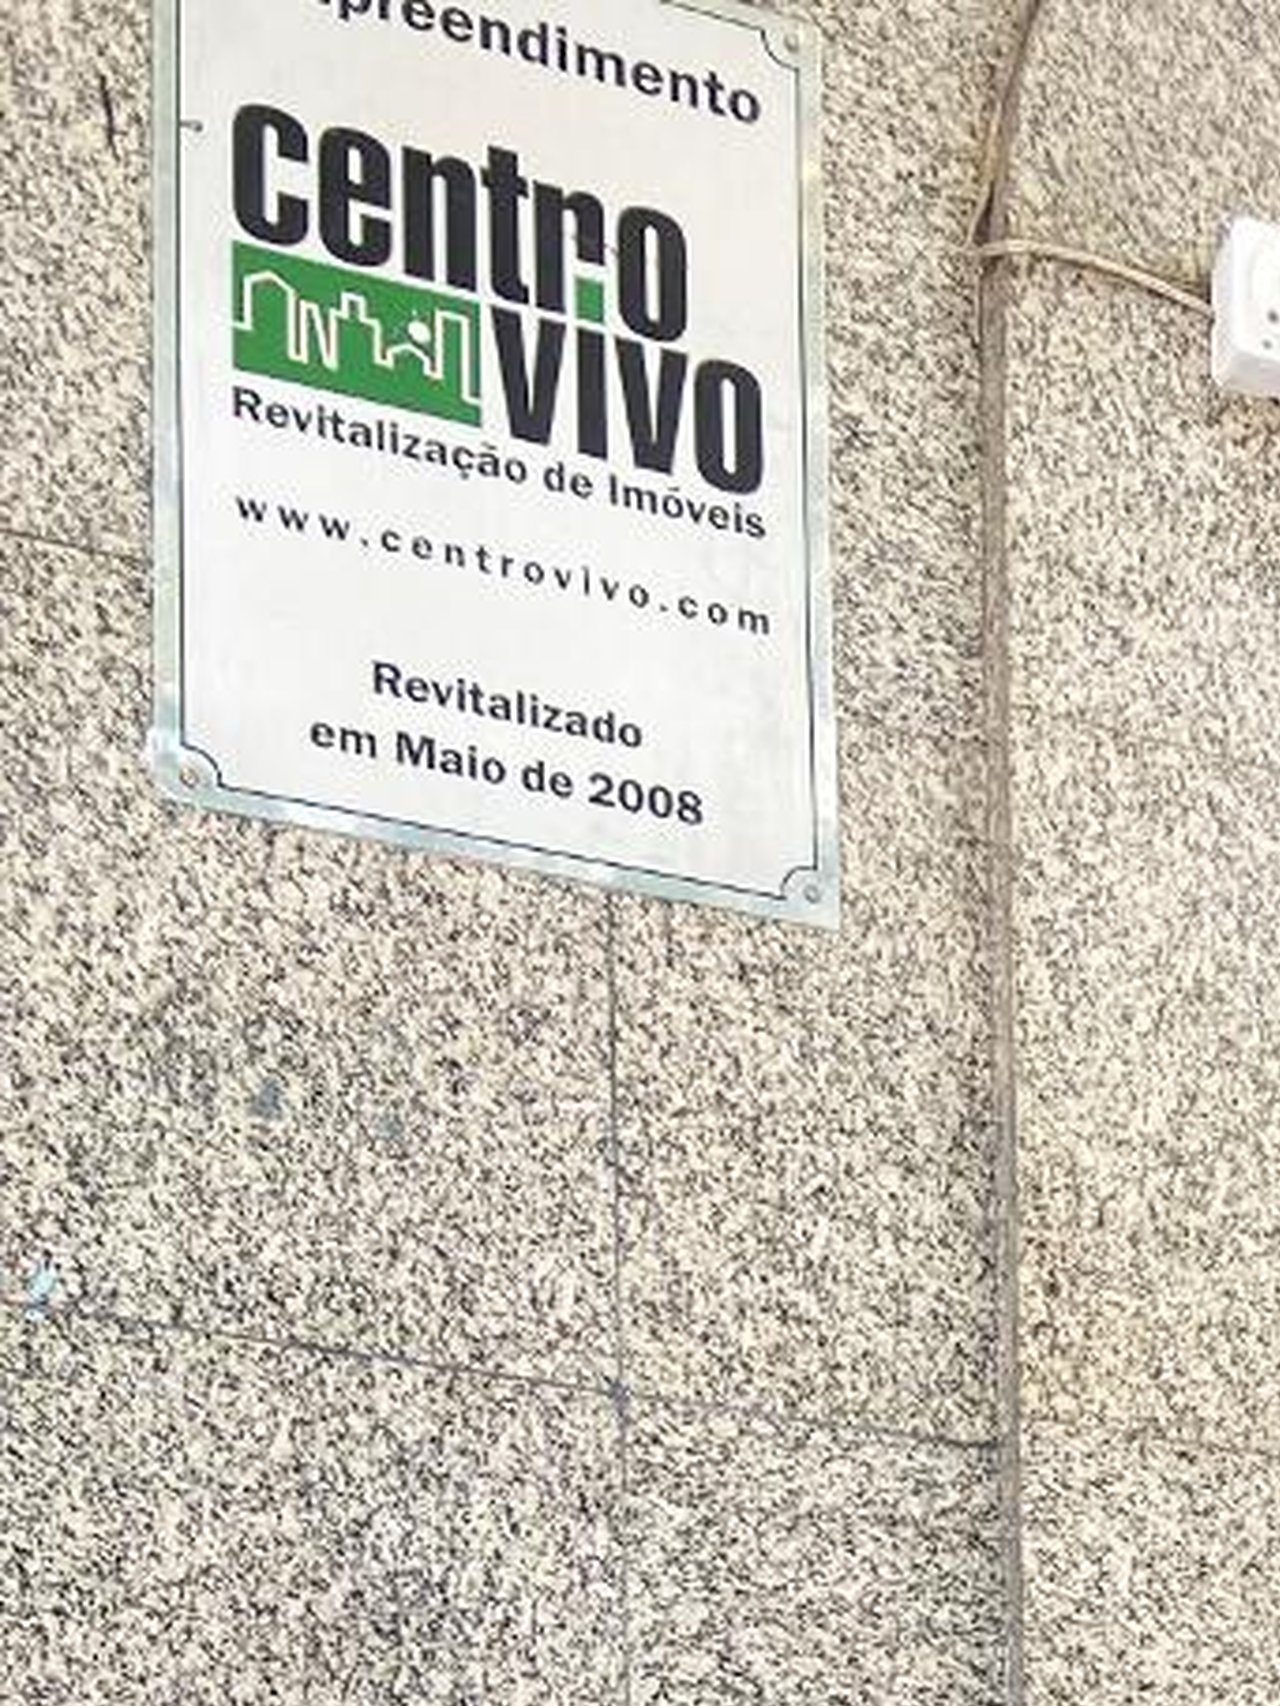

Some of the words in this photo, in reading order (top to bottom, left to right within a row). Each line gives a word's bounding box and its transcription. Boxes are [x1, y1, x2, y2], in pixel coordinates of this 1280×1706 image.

[319, 0, 761, 123] preendimento
[232, 104, 688, 343] centro
[233, 386, 527, 484] Revitalização
[543, 462, 593, 499] de
[610, 475, 767, 539] Imóveis
[236, 498, 771, 636] www.centrovivo.com
[373, 662, 643, 748] Revitalizado
[311, 723, 377, 758] em
[396, 731, 506, 785] Maio
[522, 761, 572, 798] de
[588, 773, 702, 823] 2008
